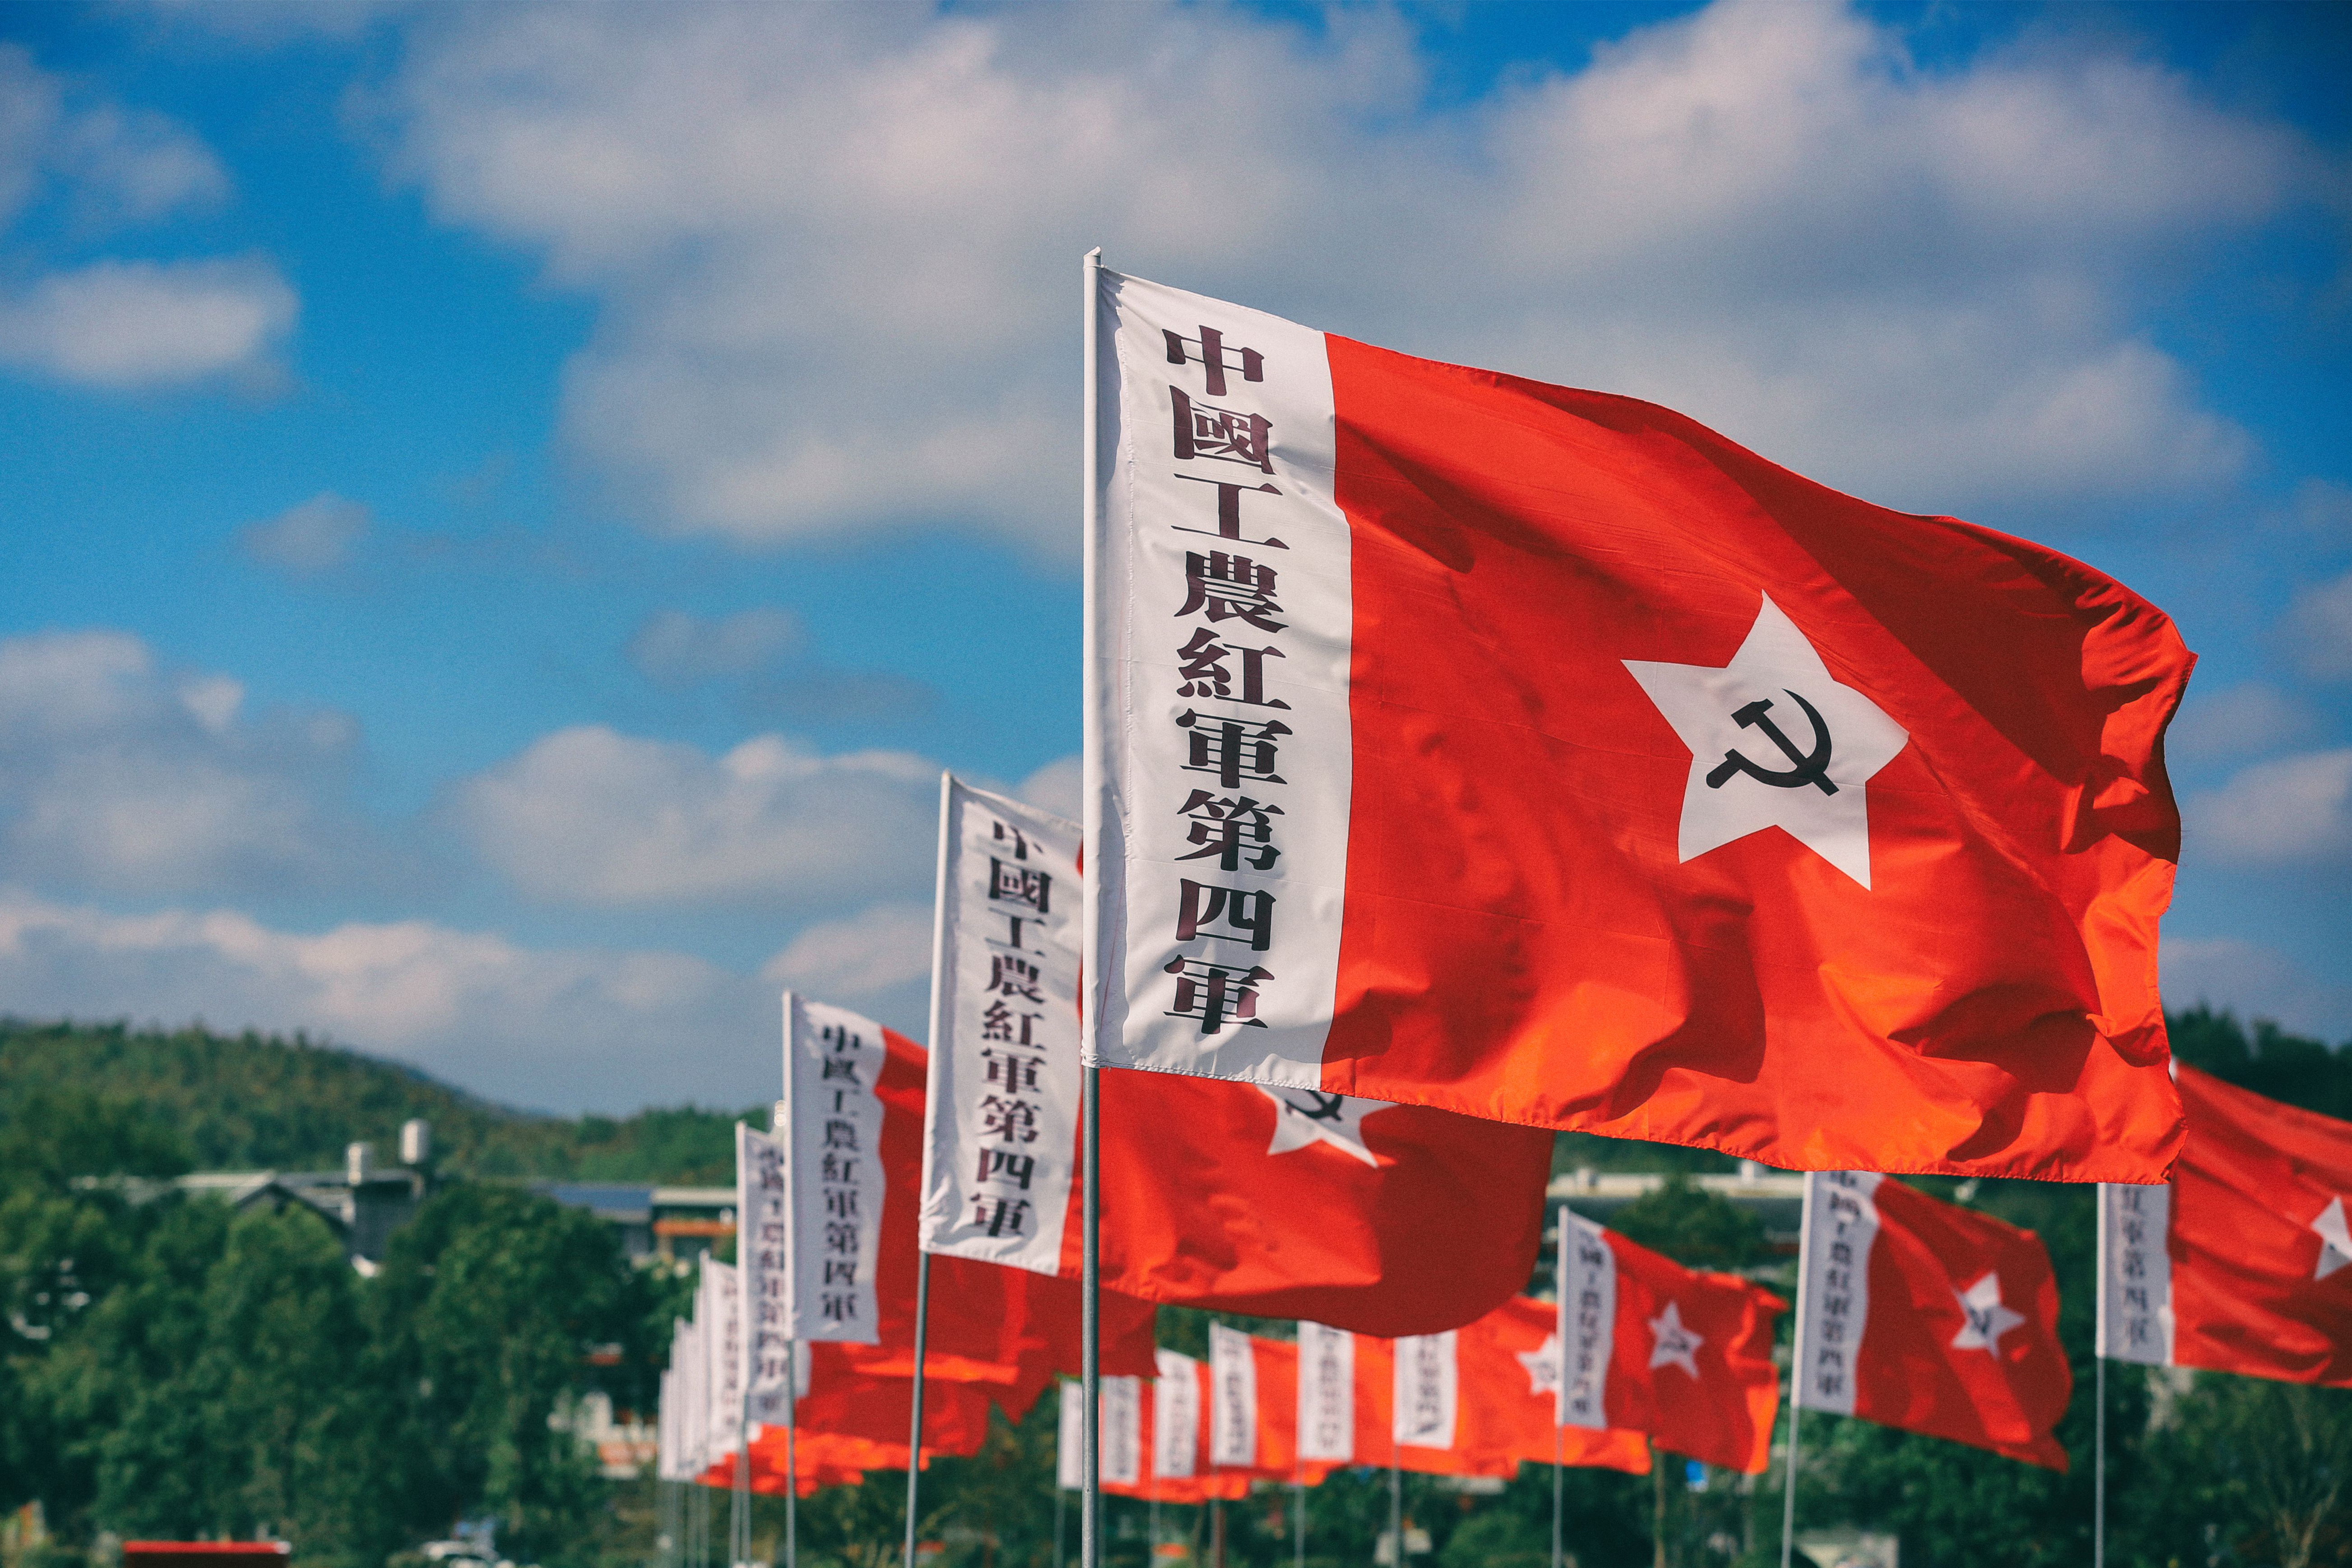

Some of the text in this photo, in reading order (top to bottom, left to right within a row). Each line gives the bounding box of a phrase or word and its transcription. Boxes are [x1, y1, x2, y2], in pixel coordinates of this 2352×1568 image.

[1162, 325, 1293, 1035] 中國工農紅軍第四軍
